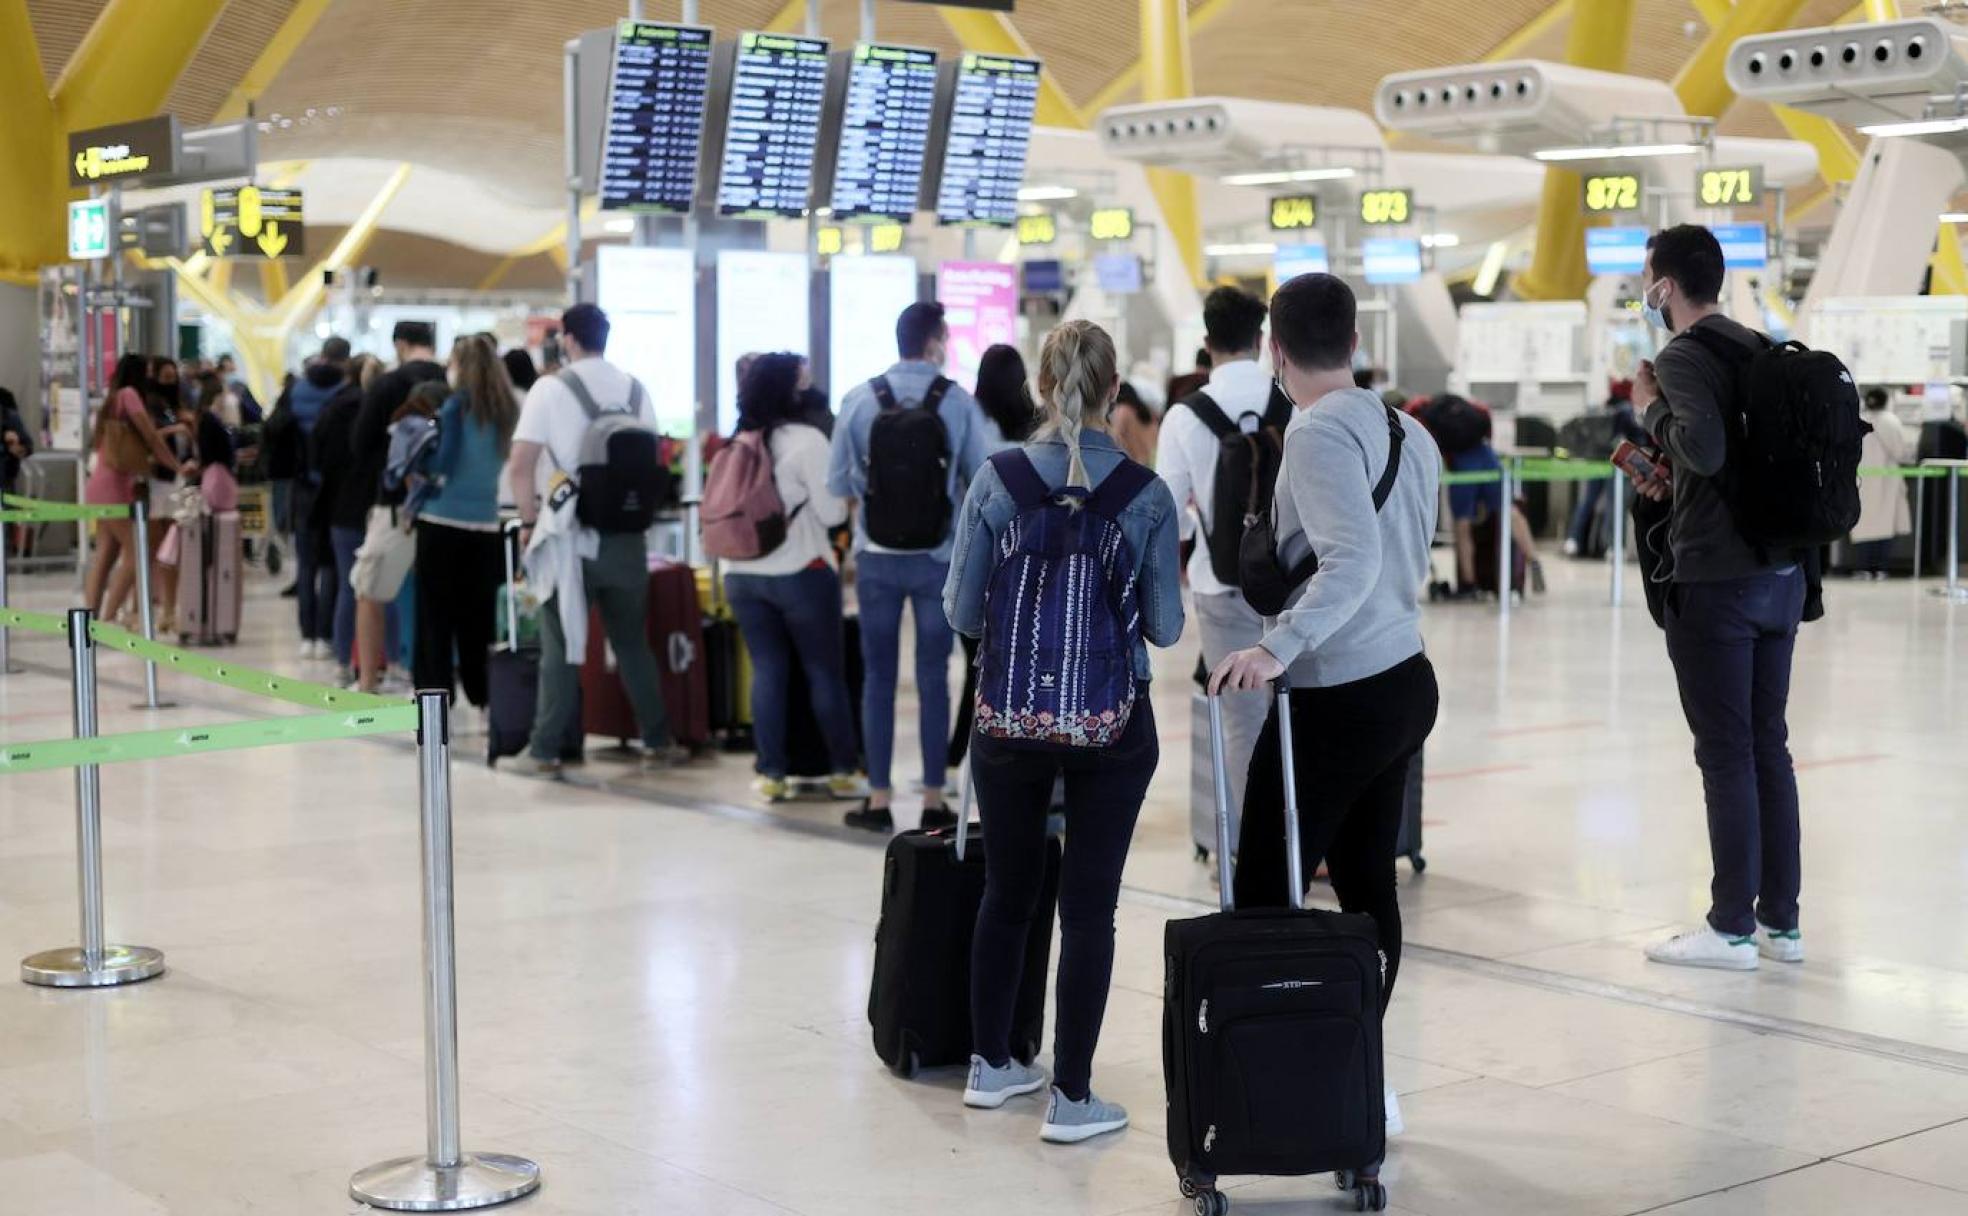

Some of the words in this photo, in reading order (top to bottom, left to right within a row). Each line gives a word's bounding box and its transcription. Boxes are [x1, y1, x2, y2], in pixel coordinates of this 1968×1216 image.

[1585, 176, 1638, 210] 872
[1701, 170, 1753, 204] 871
[1361, 189, 1409, 223] 873
